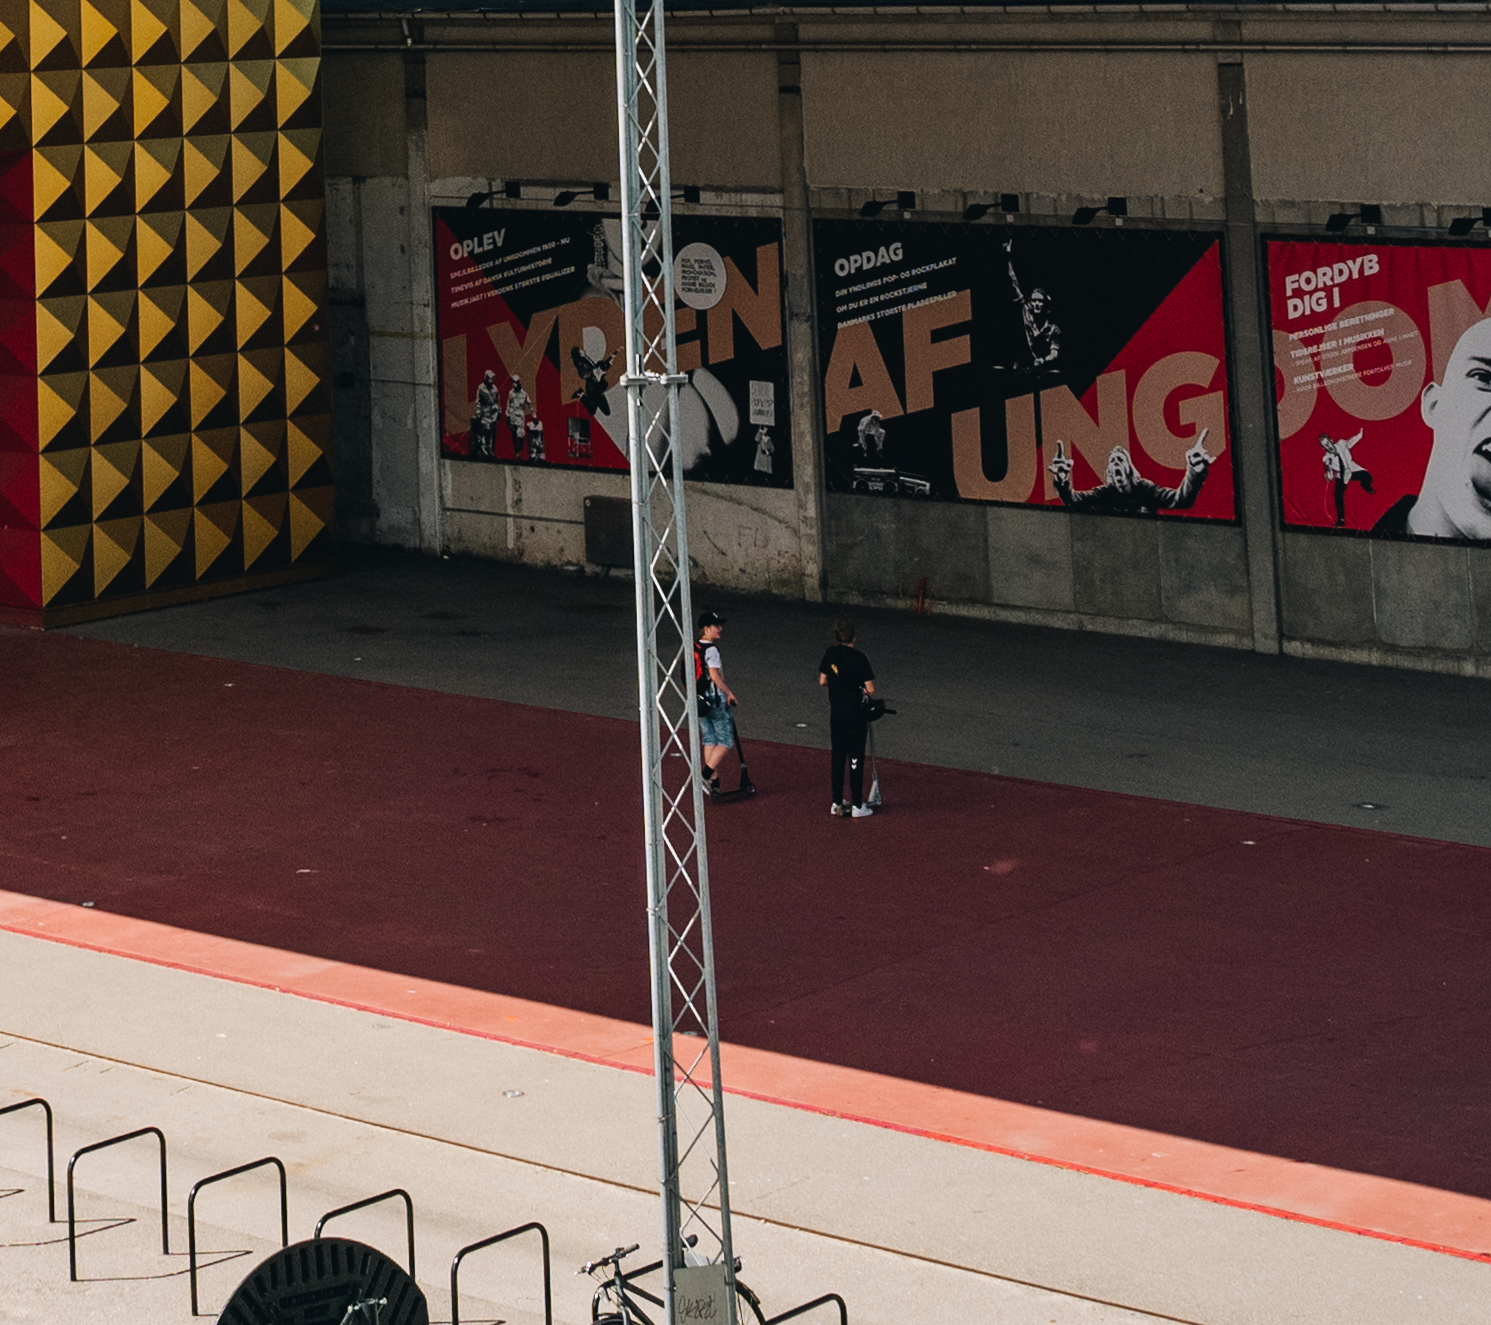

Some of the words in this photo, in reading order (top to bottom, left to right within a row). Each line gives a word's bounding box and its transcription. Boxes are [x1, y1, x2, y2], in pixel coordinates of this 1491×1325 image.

[449, 227, 506, 261] OPLEV
[560, 236, 571, 246] NU
[541, 265, 576, 282] EQUALIZER
[834, 241, 904, 277] OPDAG
[1285, 253, 1380, 297] FORDYB
[483, 273, 503, 285] DANSK
[835, 288, 848, 298] DIN
[848, 279, 882, 293] YNDLINGS
[900, 270, 910, 279] OG
[911, 257, 958, 276] ROCKPLAKAT
[836, 304, 848, 313] OM
[848, 301, 858, 310] DU
[859, 298, 869, 307] ER
[869, 295, 879, 304] EN
[880, 281, 928, 301] ROCKSTJERNE
[837, 313, 876, 330] DANMARKS
[876, 304, 907, 319] STØRSTE
[907, 290, 957, 310] PLADESPILLER
[1287, 291, 1327, 320] DIG
[1332, 287, 1341, 308] I
[1288, 322, 1338, 341] PERSONLIGE
[1339, 307, 1395, 329] BERETNINGER
[1290, 339, 1337, 359] TIDSREJSER
[1343, 327, 1385, 345] MUSIKKEN
[824, 289, 972, 435] AF
[1293, 363, 1354, 385] KUNSTVÆRKER
